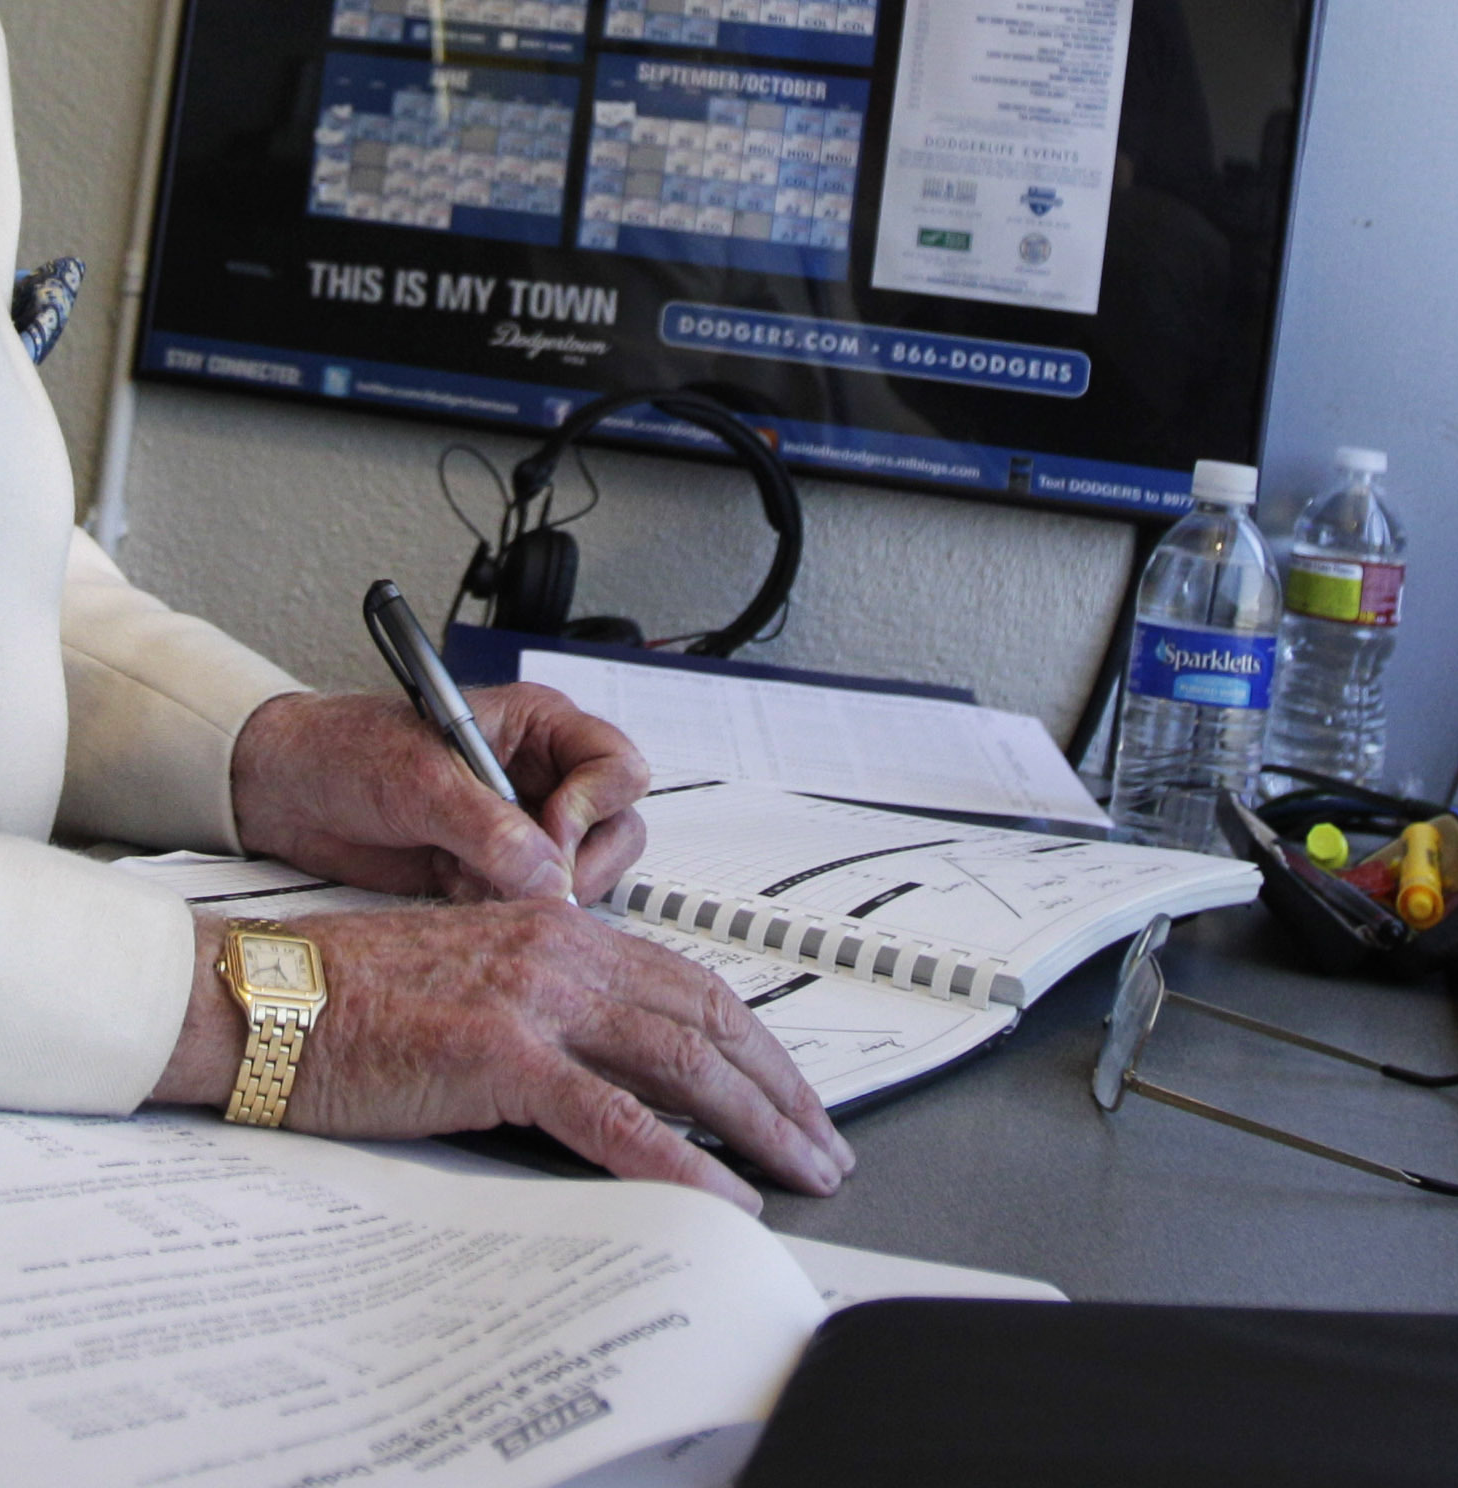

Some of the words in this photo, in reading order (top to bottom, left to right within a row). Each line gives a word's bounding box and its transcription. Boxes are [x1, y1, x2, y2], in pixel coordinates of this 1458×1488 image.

[637, 61, 827, 101] SEPTEMBER/OCTOBER
[924, 135, 1015, 158] DODGERLIFE
[1023, 145, 1080, 164] EVENTS
[308, 261, 384, 303] THIS
[394, 269, 428, 308] IS
[436, 272, 496, 313] MY
[507, 277, 618, 326] TOWN
[164, 346, 207, 371] STAY
[489, 320, 612, 360] Dodgertown
[678, 316, 859, 357] DODGERS.COM
[891, 343, 1073, 385] 866-DODGERS
[782, 439, 980, 480] insidethedodgers.mlblogs.com
[1039, 473, 1065, 490] Text
[1069, 478, 1141, 502] DODGERS
[1145, 489, 1160, 504] to
[1162, 491, 1195, 510] 9977
[1164, 642, 1262, 674] Sparkletts
[590, 1312, 691, 1360] Cincinnati
[535, 1356, 587, 1388] Reds
[465, 1399, 511, 1425] Los
[511, 1384, 532, 1401] at
[373, 1421, 466, 1468] Angeles
[497, 1394, 598, 1456] STATS
